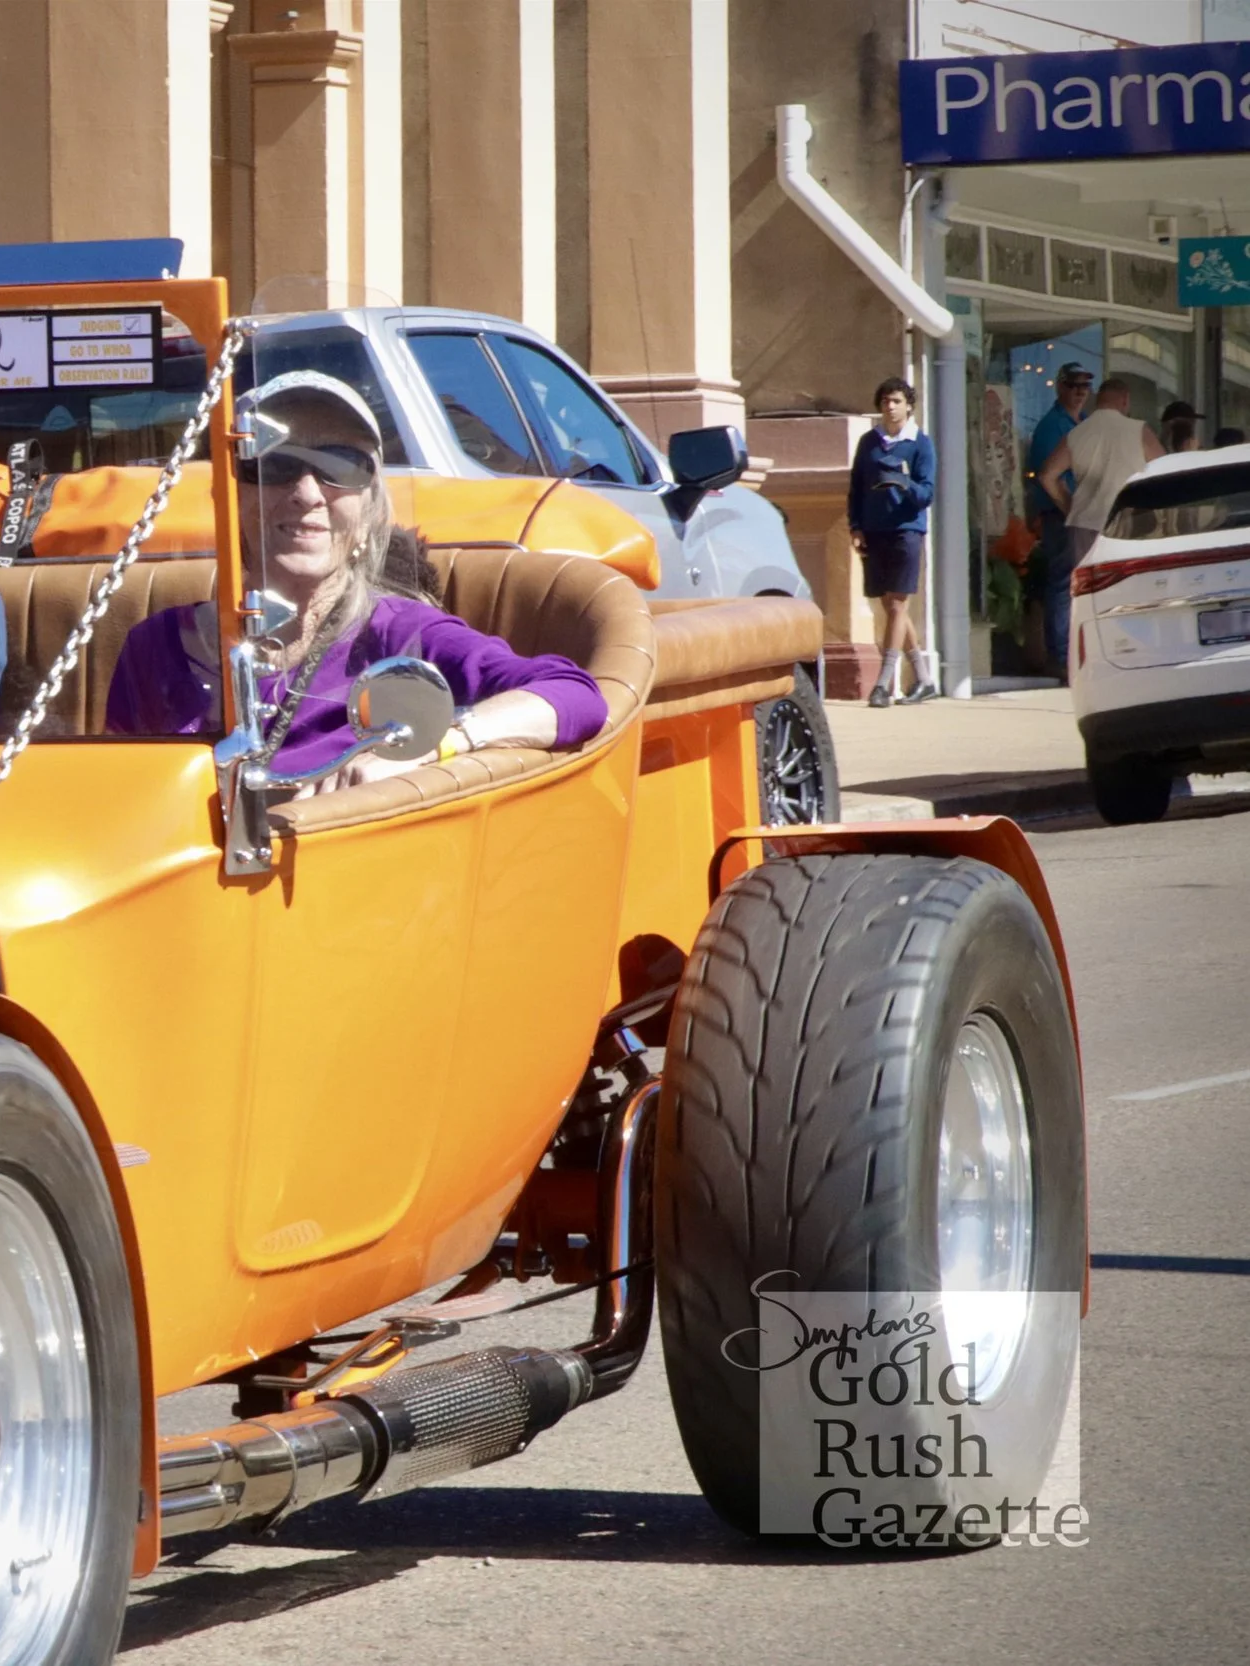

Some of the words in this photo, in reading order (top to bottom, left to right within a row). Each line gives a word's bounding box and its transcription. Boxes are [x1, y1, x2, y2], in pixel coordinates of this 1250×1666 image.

[935, 61, 1250, 136] Pharm
[79, 319, 122, 333] JUDGING
[70, 345, 85, 357] GO
[87, 344, 99, 356] TO
[102, 343, 132, 356] WHOA
[58, 368, 120, 382] OBSERVATION
[122, 366, 149, 380] RALLY
[2, 497, 25, 545] COPCO
